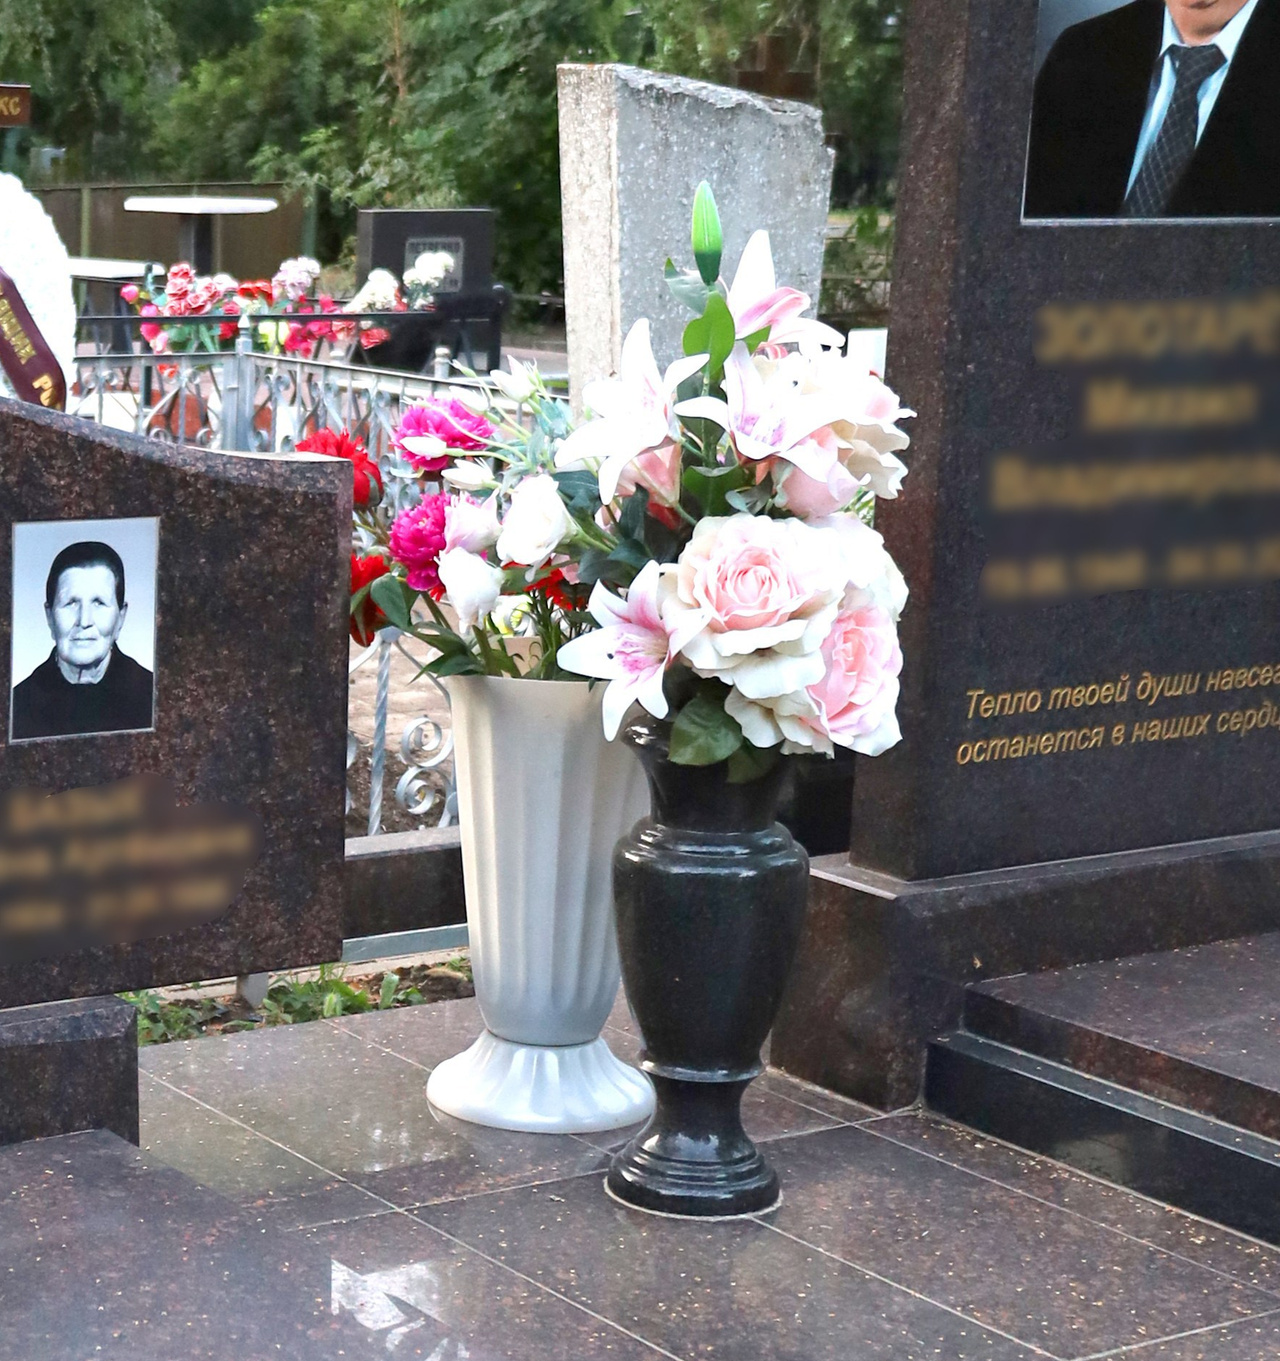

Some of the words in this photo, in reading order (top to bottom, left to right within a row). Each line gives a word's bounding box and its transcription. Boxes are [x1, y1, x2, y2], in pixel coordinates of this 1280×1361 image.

[966, 687, 1042, 719] Тепло
[1047, 674, 1131, 711] твоей
[1136, 671, 1201, 706] души
[956, 725, 1105, 764] останется
[1111, 724, 1126, 745] в
[1131, 713, 1212, 743] наших
